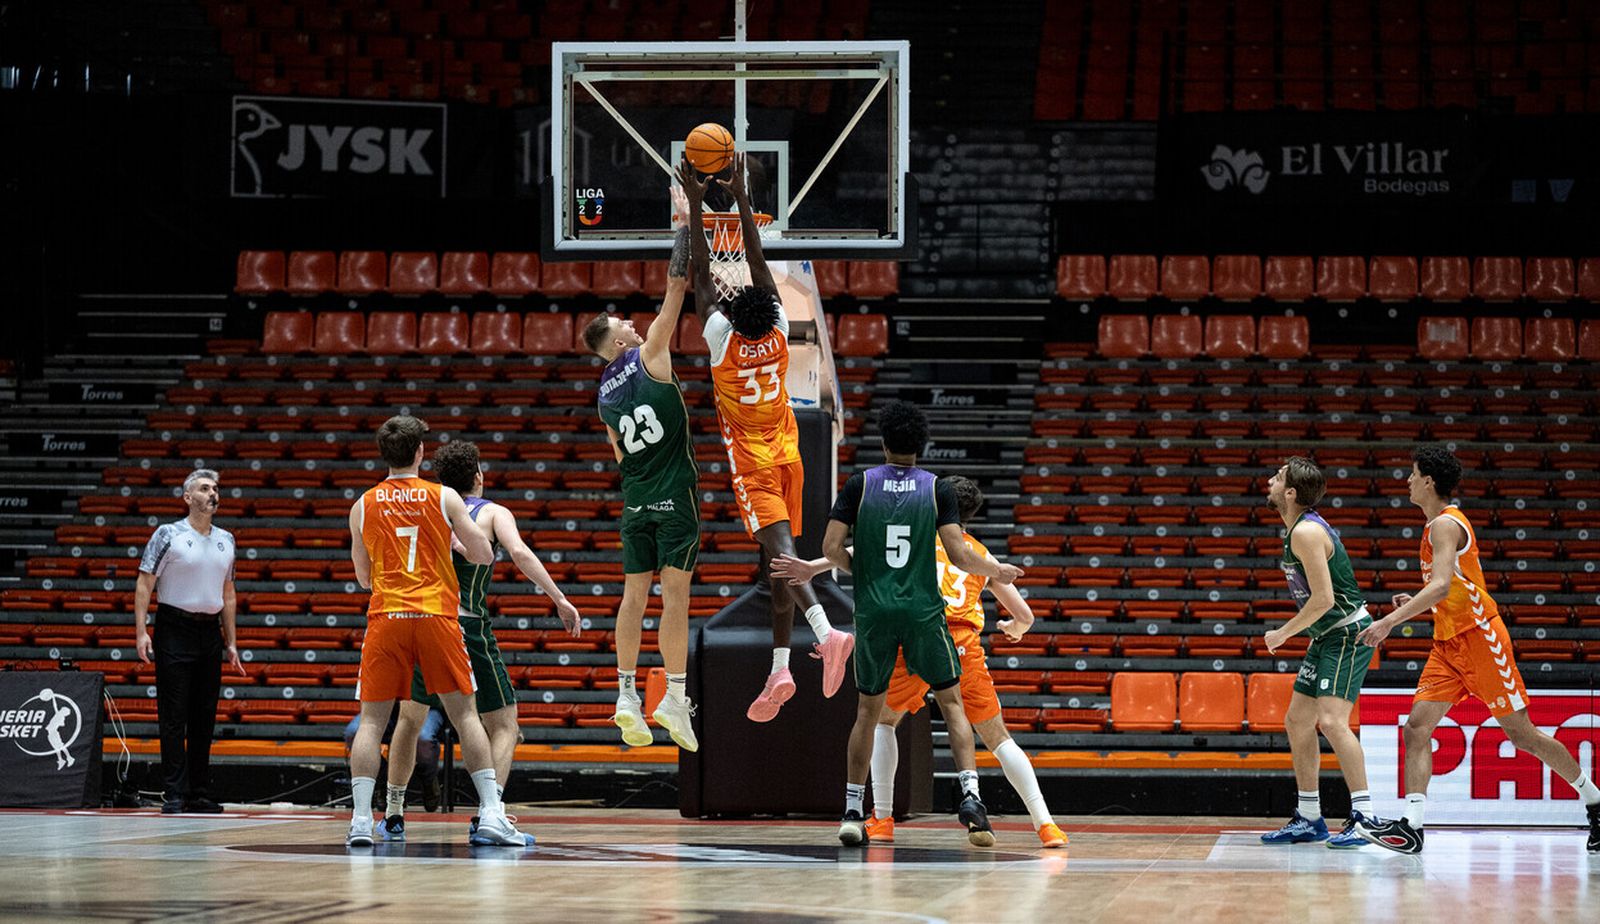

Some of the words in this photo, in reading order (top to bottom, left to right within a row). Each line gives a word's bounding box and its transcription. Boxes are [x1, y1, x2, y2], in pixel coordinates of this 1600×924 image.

[276, 123, 434, 175] JYSK
[1280, 142, 1322, 176] El
[1332, 141, 1450, 176] Villar
[576, 188, 604, 199] LIGA
[1363, 178, 1450, 196] Bodegas
[738, 337, 779, 358] OSAYI
[81, 384, 124, 401] Torres
[738, 363, 781, 404] 33
[931, 389, 976, 406] Torres
[618, 404, 664, 454] 23
[41, 433, 87, 451] Torres
[883, 477, 916, 492] MEJÍA
[376, 488, 427, 502] BLANCO
[396, 526, 419, 573] 7
[886, 525, 911, 568] 5
